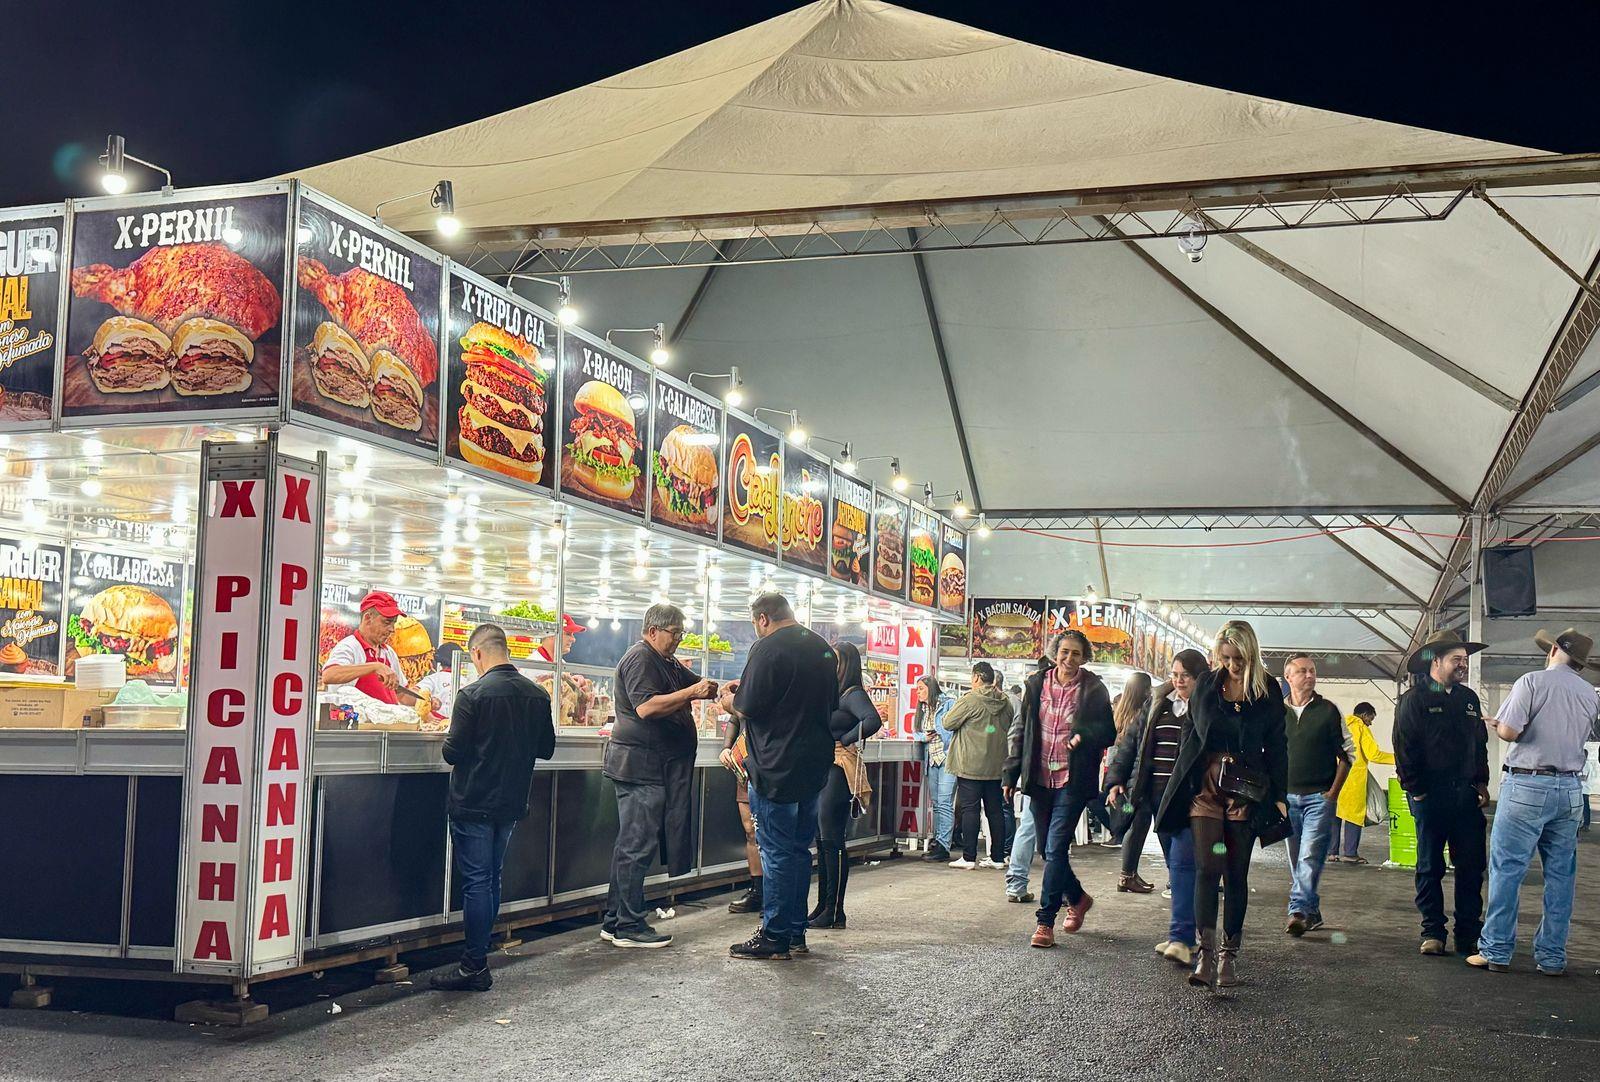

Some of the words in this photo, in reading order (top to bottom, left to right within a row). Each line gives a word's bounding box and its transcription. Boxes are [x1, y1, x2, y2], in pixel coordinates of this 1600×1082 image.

[0, 275, 32, 321] AL
[0, 331, 51, 366] efumada
[524, 313, 546, 349] CIA
[220, 480, 256, 518] X
[282, 474, 311, 524] X
[321, 582, 352, 603] ERNIL
[985, 603, 1012, 616] BACON
[1012, 602, 1042, 623] SALADA
[1051, 606, 1069, 629] X
[906, 626, 925, 648] X
[194, 575, 251, 960] PICANHA
[258, 563, 308, 941] PICANHA
